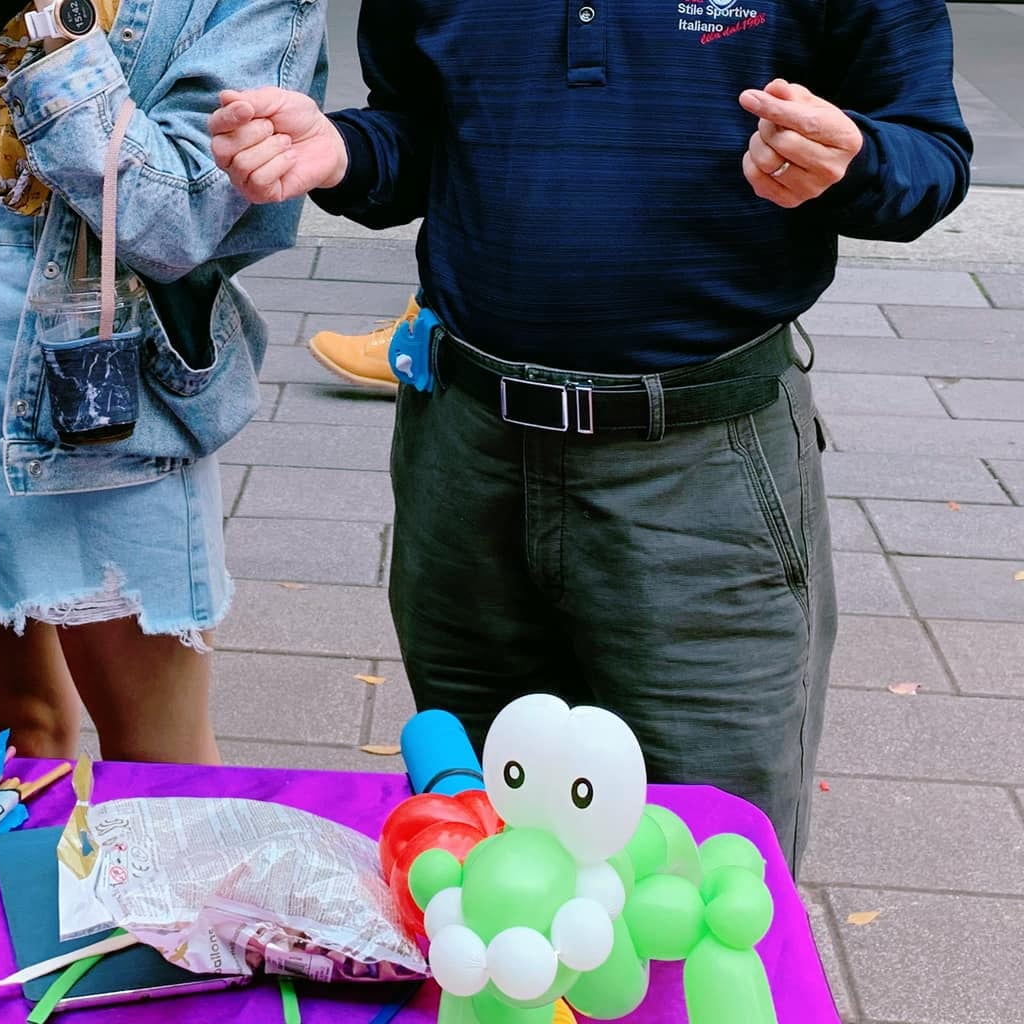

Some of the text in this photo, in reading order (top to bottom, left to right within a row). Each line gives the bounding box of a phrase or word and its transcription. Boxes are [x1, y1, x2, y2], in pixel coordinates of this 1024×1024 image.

[70, 0, 84, 28] 15:42
[678, 3, 757, 19] Stile Sportive
[679, 18, 724, 33] Italiano
